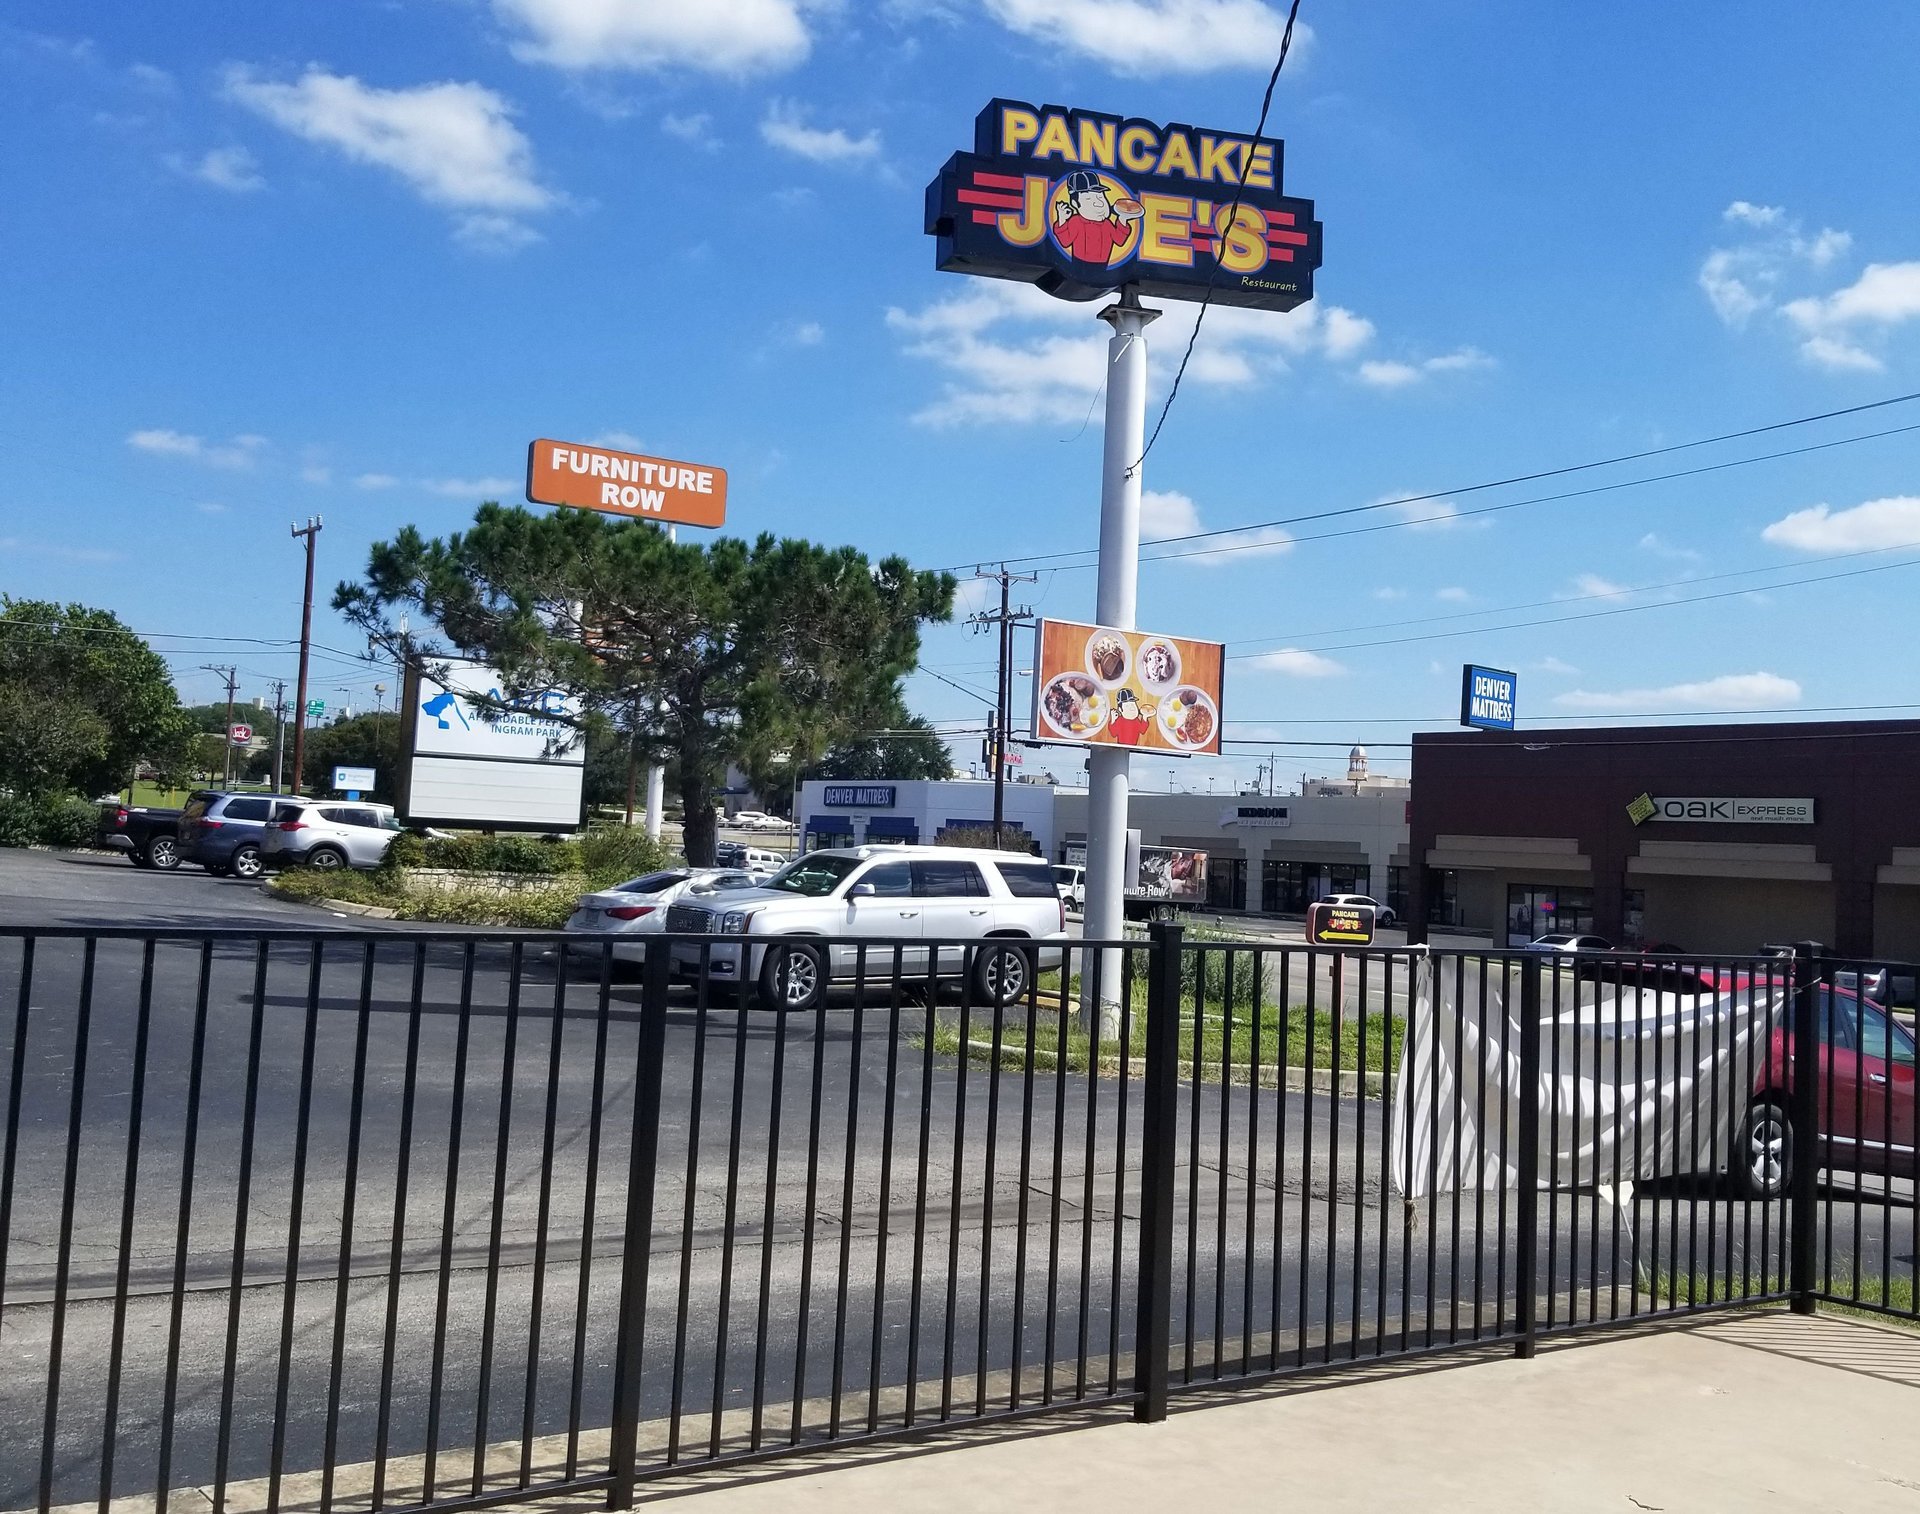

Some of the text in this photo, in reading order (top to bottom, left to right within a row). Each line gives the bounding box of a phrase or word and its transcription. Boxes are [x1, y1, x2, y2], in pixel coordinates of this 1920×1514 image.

[1003, 108, 1275, 189] PANCAKE
[998, 169, 1269, 272] JOE'S
[1241, 275, 1297, 291] Restaurant
[552, 448, 713, 494] FURNITURE
[601, 482, 665, 512] ROW
[1475, 675, 1510, 701] DENVER
[468, 711, 536, 725] AFRDABLE
[1471, 696, 1512, 722] MATTRESS
[491, 724, 562, 738] INGRAM PARK
[825, 788, 889, 804] DENVER MATTRESS
[1737, 806, 1807, 815] EXPRESS
[1332, 910, 1359, 918] PANCAKE
